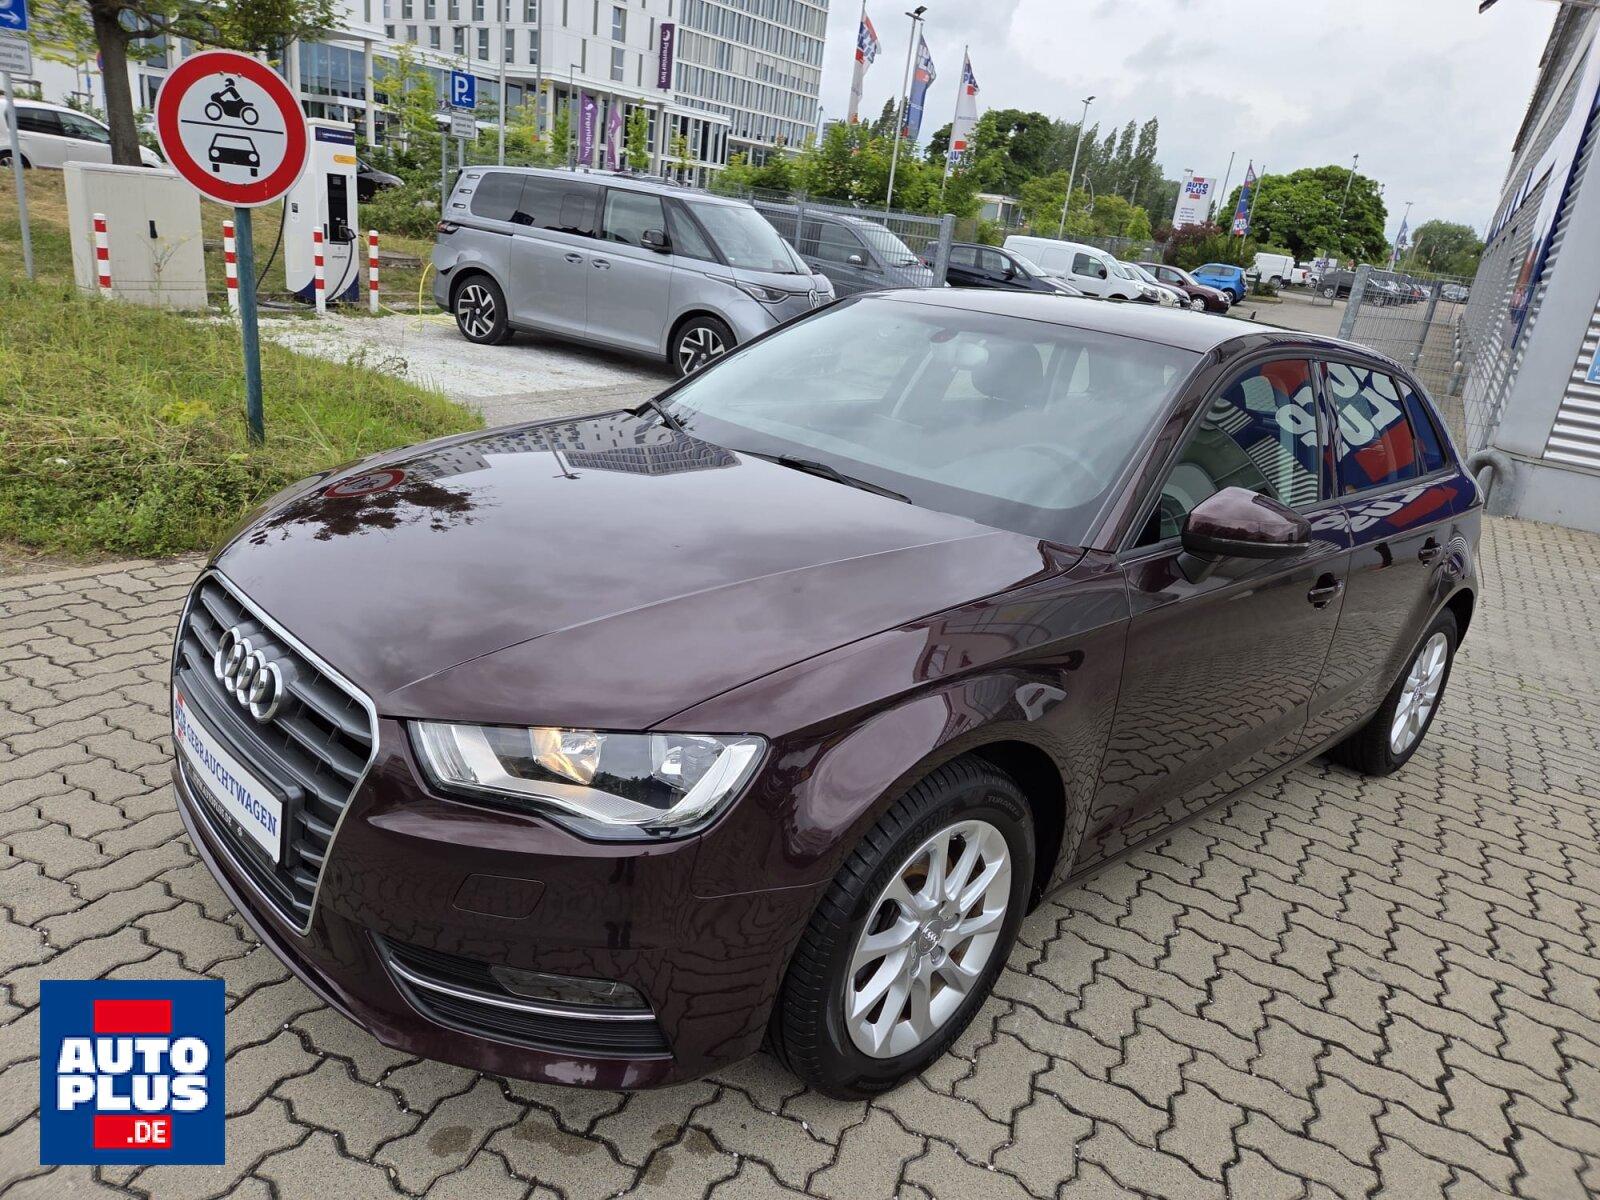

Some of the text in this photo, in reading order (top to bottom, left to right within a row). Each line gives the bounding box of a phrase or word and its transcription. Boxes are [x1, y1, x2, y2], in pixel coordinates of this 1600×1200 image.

[455, 75, 469, 102] P
[1185, 187, 1207, 195] PLUS
[1186, 181, 1208, 189] AUTO
[186, 724, 277, 837] GEBRAUCHTWAGEN
